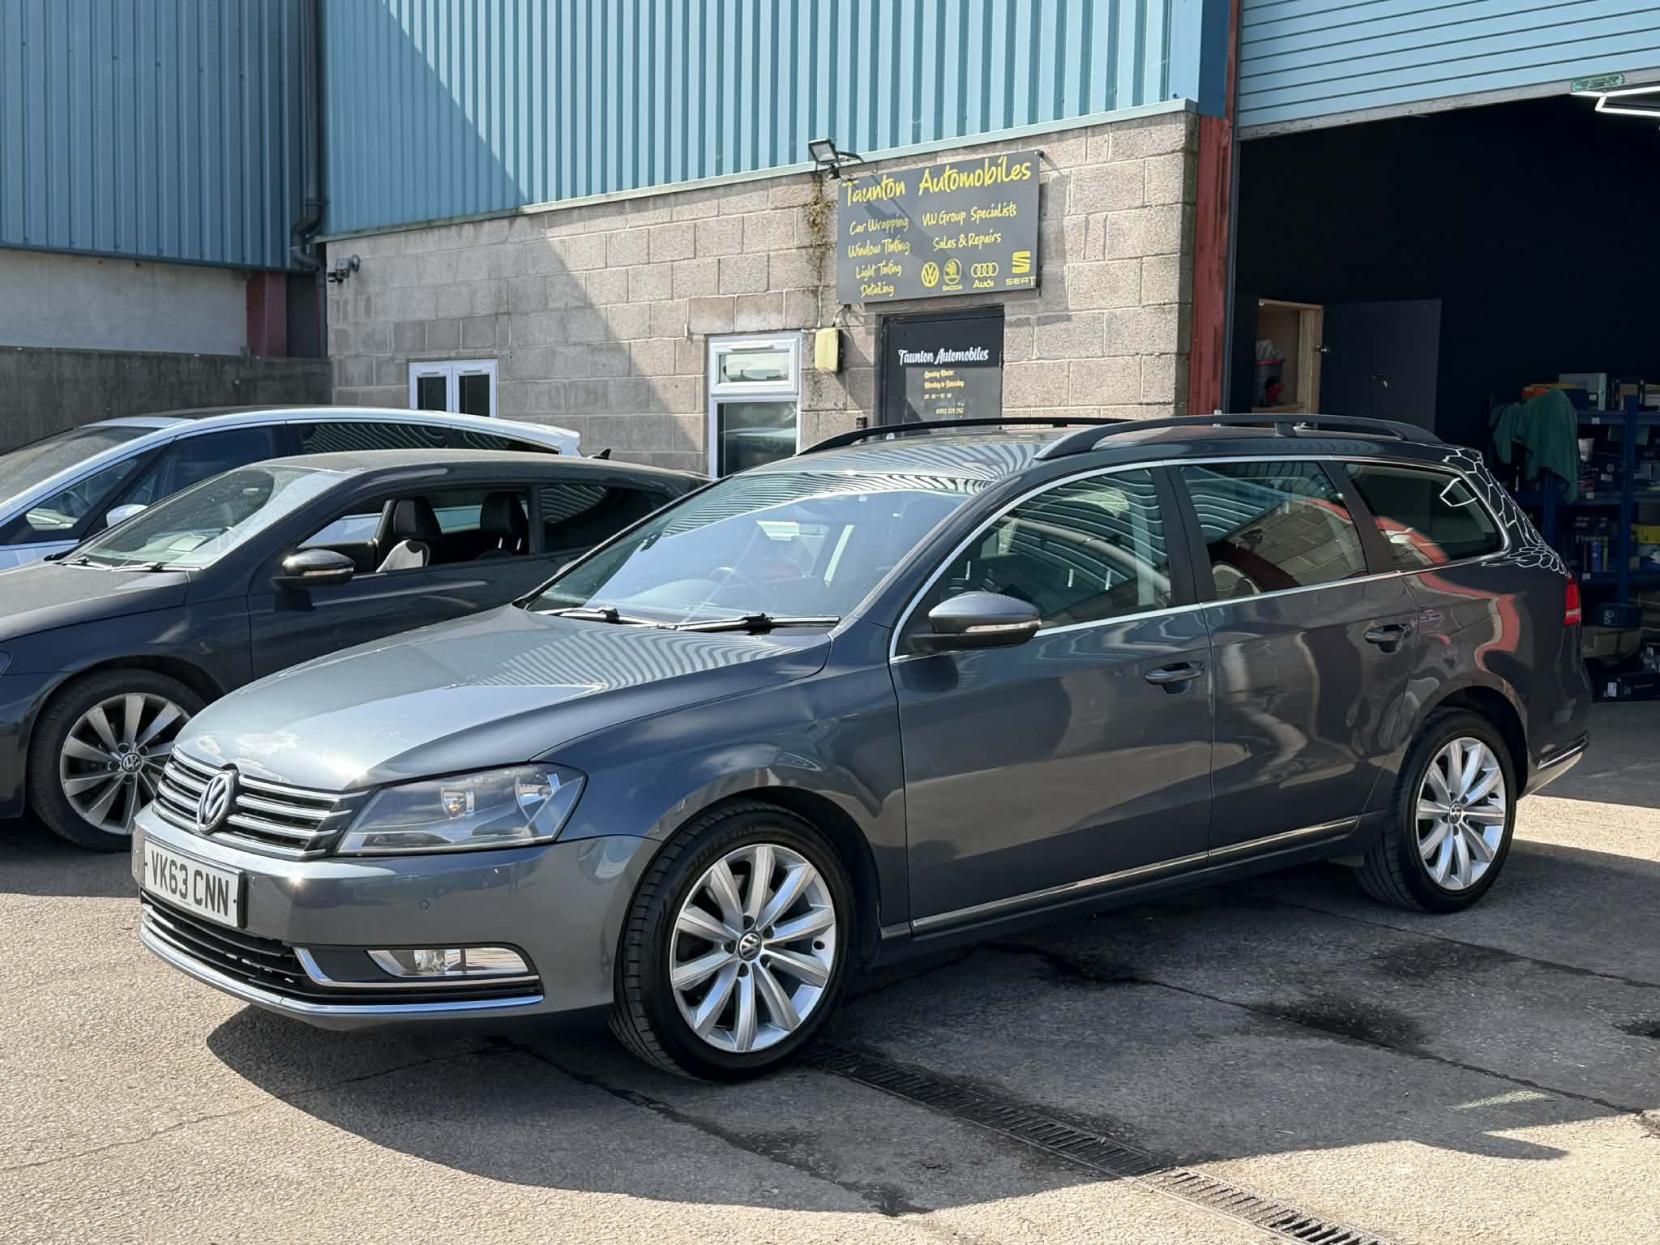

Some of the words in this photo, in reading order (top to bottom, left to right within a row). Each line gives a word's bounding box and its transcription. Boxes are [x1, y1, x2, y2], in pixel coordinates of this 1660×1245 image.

[841, 174, 906, 206] Taunton
[918, 155, 1032, 195] Automobiles
[849, 220, 867, 236] Car
[867, 212, 909, 234] Wrapping
[922, 212, 938, 226] VW
[939, 210, 966, 226] Group
[970, 201, 1017, 224] Specialists
[847, 239, 881, 258] Window
[881, 235, 911, 255] Tinting
[933, 235, 957, 251] Sales
[958, 234, 967, 248] &
[968, 228, 1002, 250] Repairs
[855, 264, 876, 281] Light
[877, 259, 902, 277] Tinting
[1005, 276, 1036, 287] SEAT
[860, 281, 895, 298] Detailing
[973, 279, 994, 289] Audi
[898, 349, 935, 366] Taunton
[934, 346, 989, 365] Automobiles
[151, 849, 189, 900] VK63
[193, 869, 230, 917] CNN
